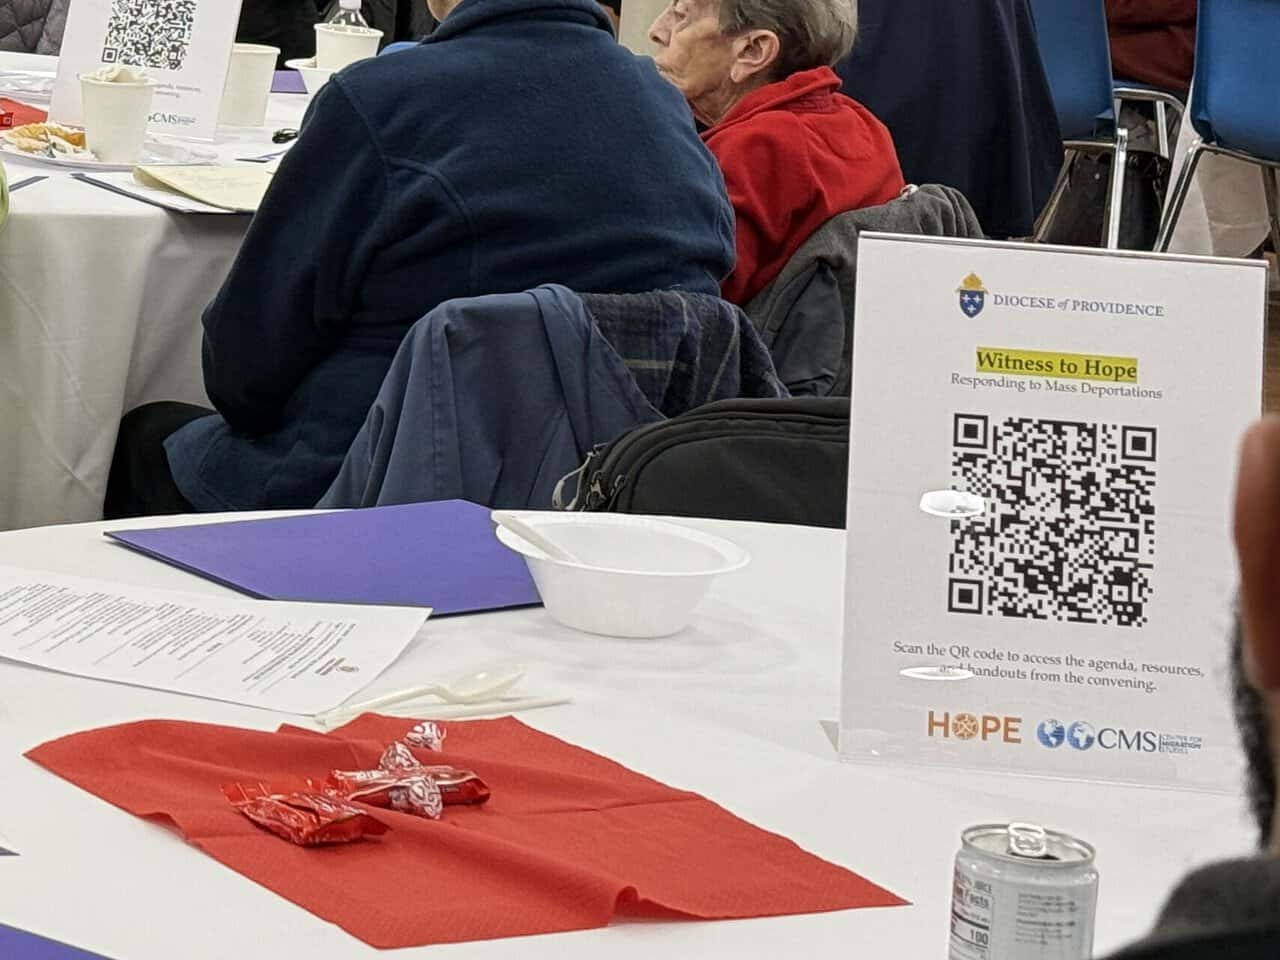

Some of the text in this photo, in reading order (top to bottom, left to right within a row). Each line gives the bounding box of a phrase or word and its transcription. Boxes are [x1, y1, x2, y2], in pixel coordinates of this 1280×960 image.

[993, 294, 1164, 317] DIOCESE of PROVIDENCE
[977, 351, 1137, 382] Witness to Hope
[951, 373, 1163, 400] Responding to Mass Deportations
[893, 641, 1205, 679] Scan the QR code to access the agenda, resources,
[968, 664, 1027, 680] handouts
[1030, 668, 1061, 683] from
[1064, 671, 1084, 685] the
[1087, 674, 1158, 693] convening.
[928, 710, 1158, 753] HOPE CMS
[970, 929, 989, 946] 100
